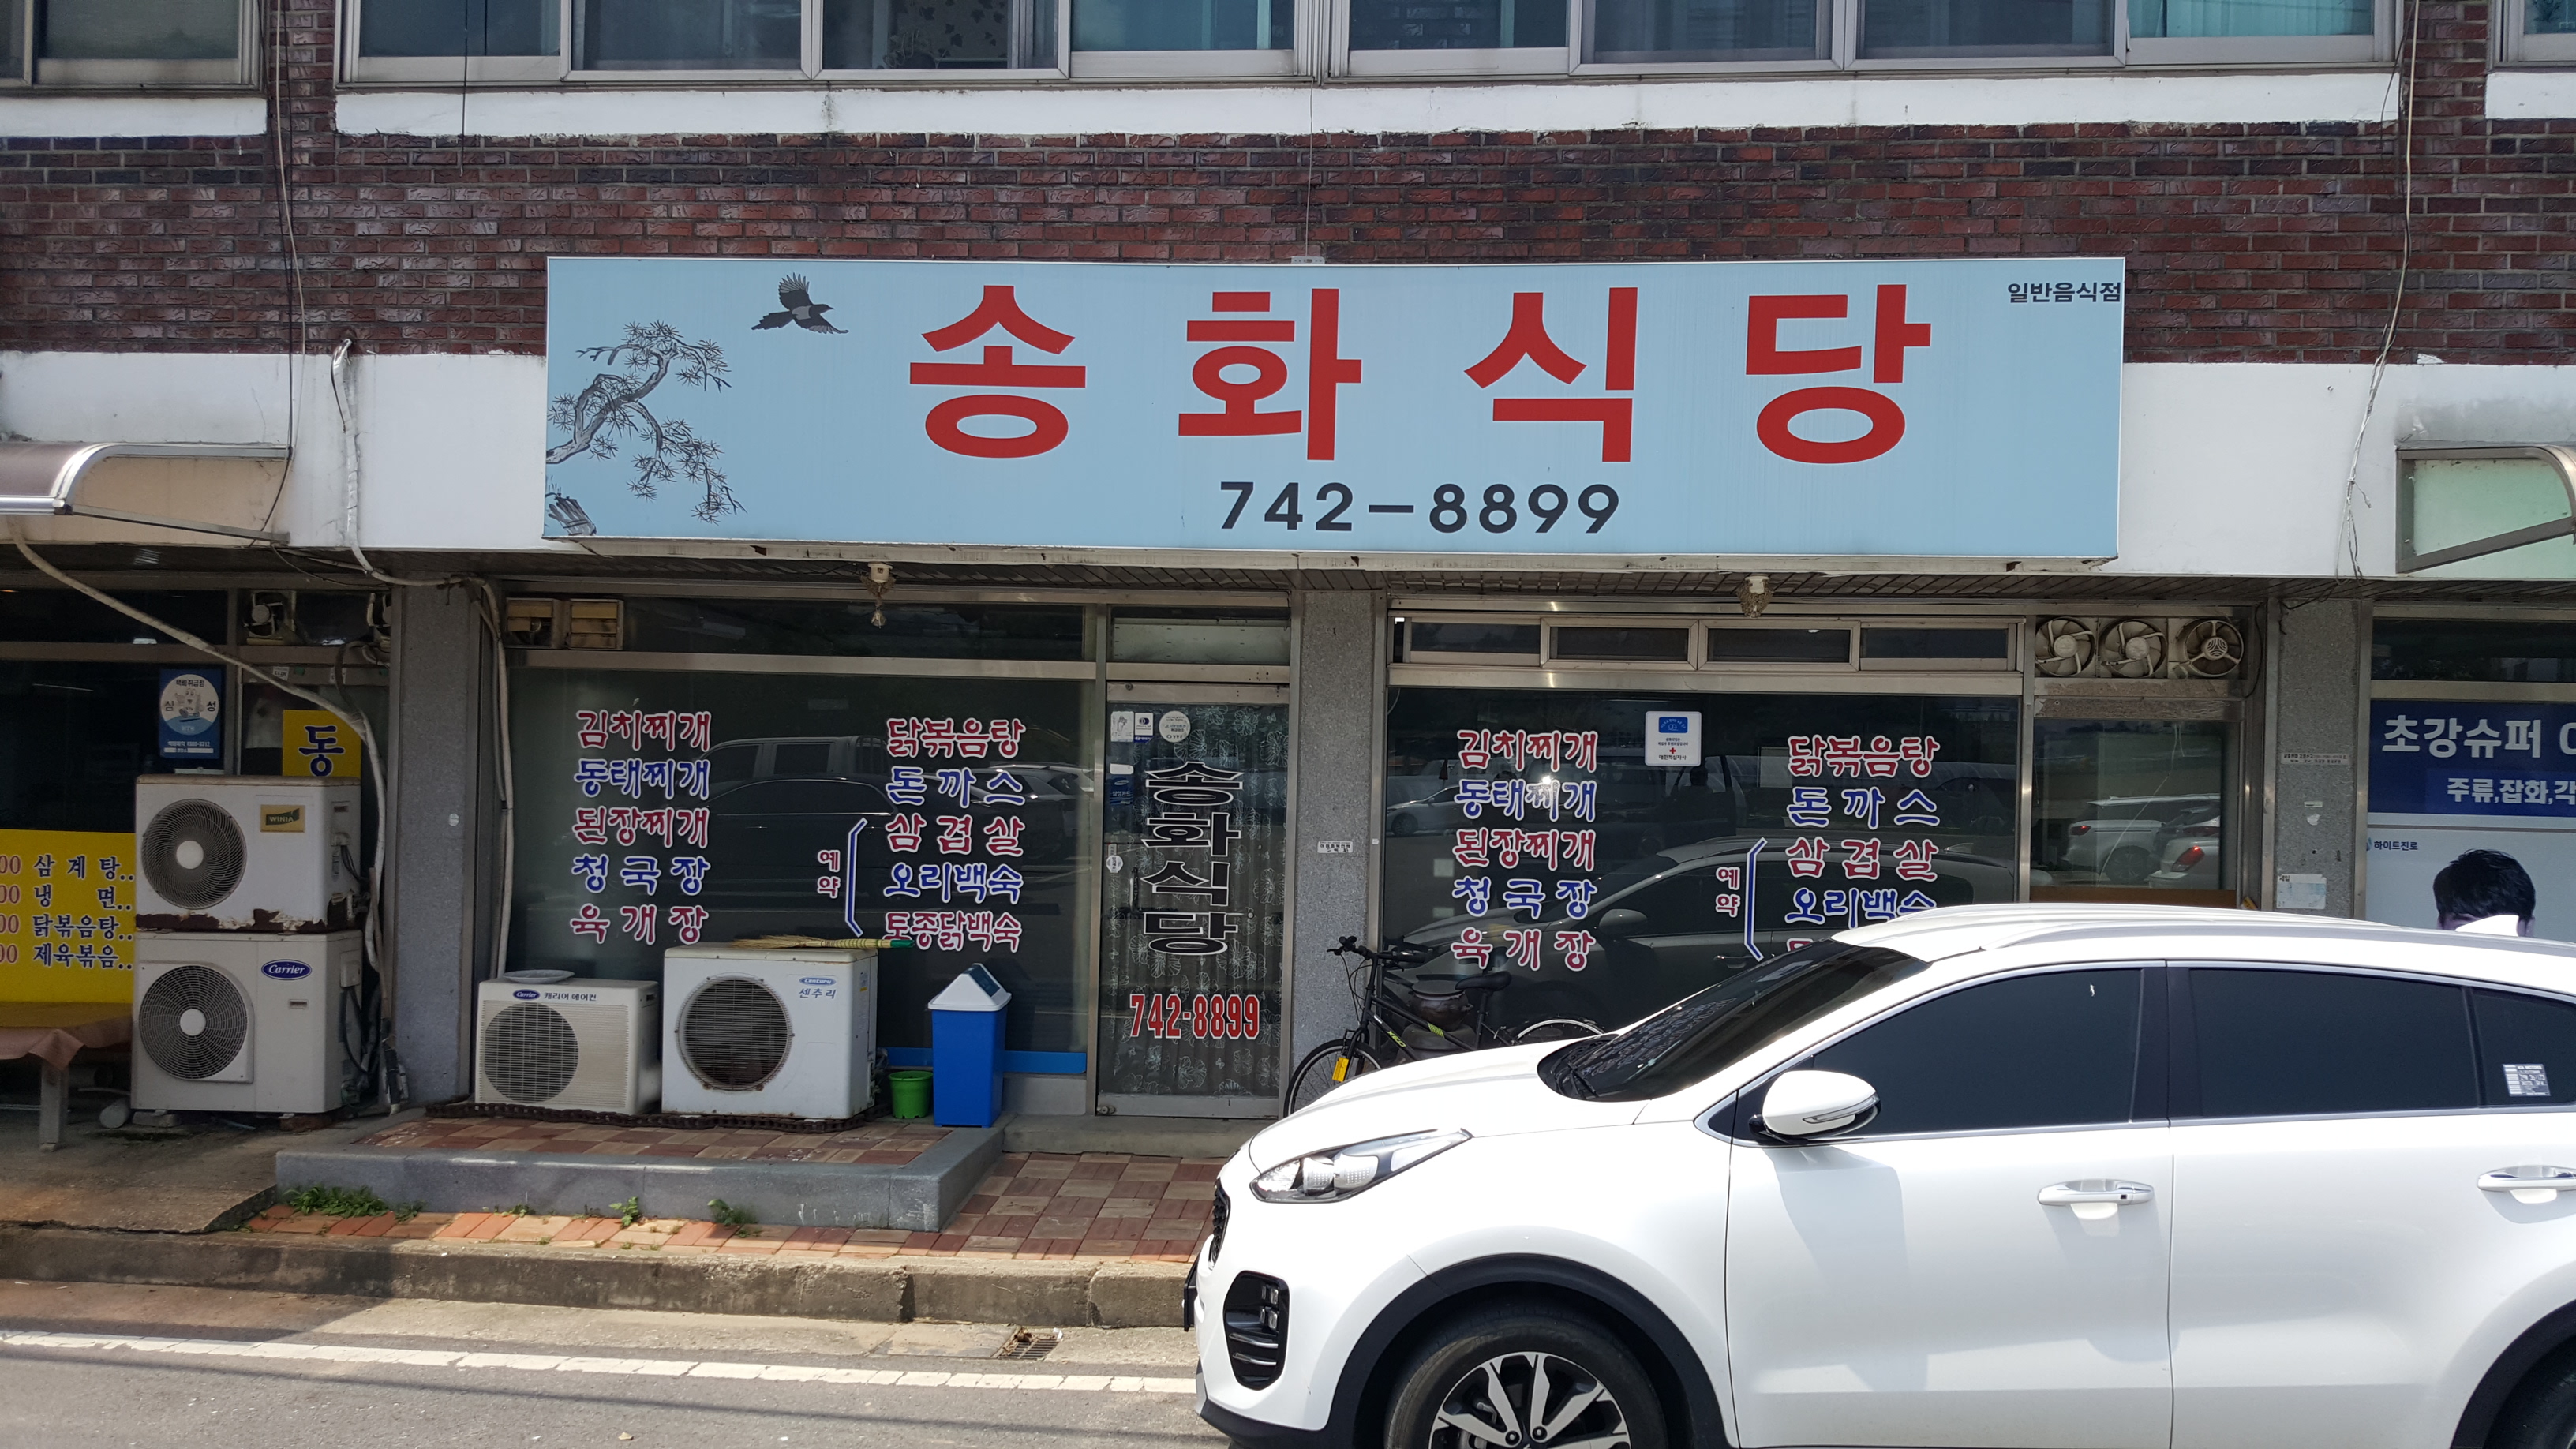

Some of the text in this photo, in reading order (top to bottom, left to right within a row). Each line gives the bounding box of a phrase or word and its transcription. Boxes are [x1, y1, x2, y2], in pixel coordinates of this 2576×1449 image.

[2007, 279, 2123, 304] 일반음식점
[909, 283, 1932, 465] 송화식당
[1219, 481, 1620, 534] 742-8899
[298, 724, 346, 777] 동
[576, 710, 711, 751] 김치찌개
[886, 717, 1025, 758] 닭볶음탕
[1457, 729, 1598, 773] 김치찌개
[2382, 714, 2541, 758] 초강슈퍼
[1788, 735, 1940, 778] 닭볶음탕
[574, 758, 710, 799] 동태찌개
[885, 766, 1024, 807] 돈까스
[1454, 779, 1597, 822] 동태찌개
[1786, 786, 1940, 830] 돈까스
[572, 806, 710, 848] 된장찌개
[885, 813, 1024, 856] 삼겹살
[2374, 841, 2418, 851] 하이트진로
[1140, 761, 1245, 956] 송화식당
[1452, 829, 1596, 871] 된장찌개
[1785, 836, 1939, 881] 삼겹살
[572, 854, 710, 895] 청국장
[883, 862, 1024, 904] 오리백숙
[1451, 876, 1597, 920] 청국장
[570, 904, 709, 945] 육개장
[882, 910, 1022, 953] 토종닭백숙
[268, 964, 305, 975] Carrier
[1450, 927, 1596, 972] 육개장
[799, 988, 836, 999] 센추리
[1129, 994, 1260, 1040] 742-8899
